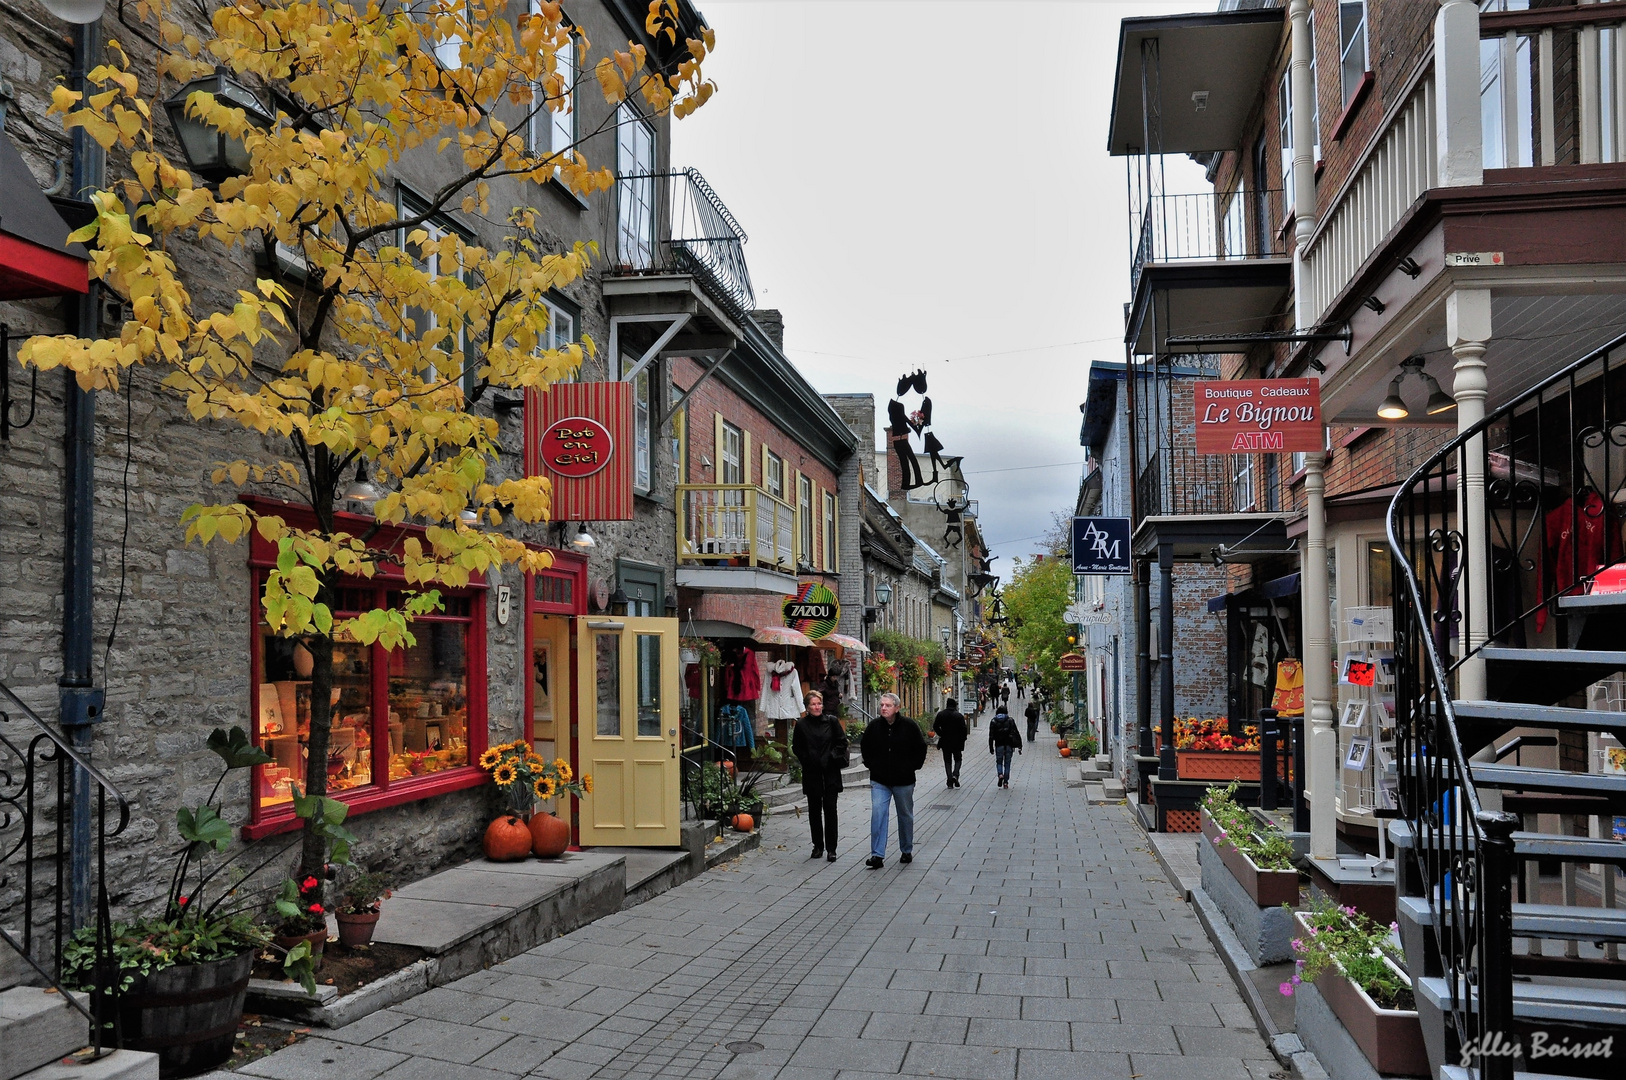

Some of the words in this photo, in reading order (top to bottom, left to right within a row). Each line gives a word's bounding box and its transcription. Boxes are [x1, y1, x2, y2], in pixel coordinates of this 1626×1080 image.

[1455, 254, 1480, 263] Privé
[1205, 388, 1253, 400] Boutique
[1260, 386, 1310, 397] Cadeaux
[1201, 402, 1231, 424] Le
[1235, 400, 1314, 430] Bignou
[555, 427, 595, 439] Pot
[563, 441, 592, 449] en
[1231, 431, 1284, 450] ATM
[555, 451, 598, 464] Ciel
[500, 591, 508, 603] 27
[791, 605, 829, 617] ZAZOU
